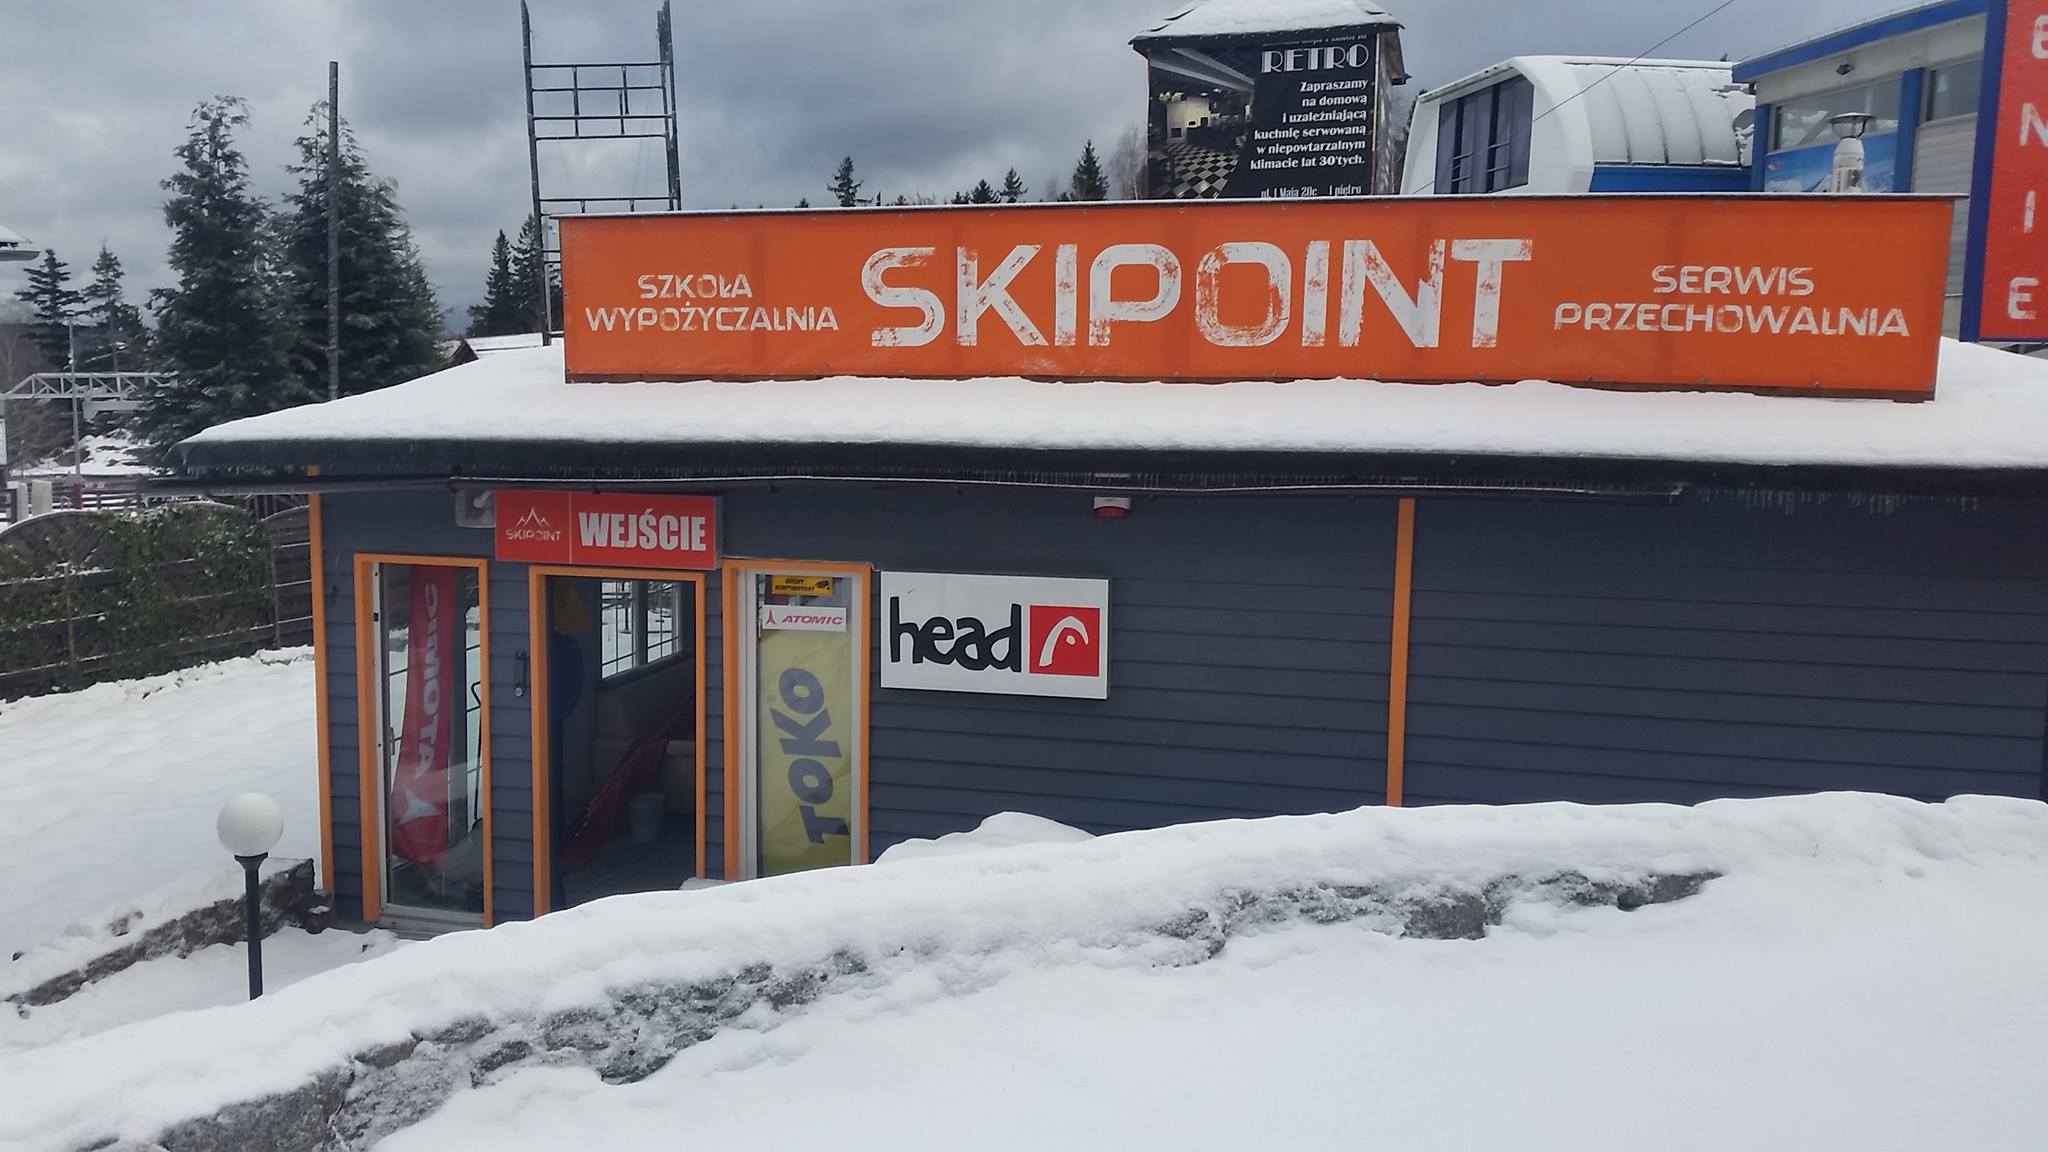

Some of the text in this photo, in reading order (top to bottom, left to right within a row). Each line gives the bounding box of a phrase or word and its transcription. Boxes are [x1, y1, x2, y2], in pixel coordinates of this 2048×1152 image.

[1261, 43, 1370, 73] RETRO
[1300, 79, 1369, 93] Zapraszamy
[1302, 94, 1368, 107] na domową
[1282, 109, 1367, 123] i uzależniającą
[1254, 125, 1367, 140] kuchnię serwowaną
[1268, 140, 1366, 155] niepowtarzalnym
[1250, 157, 1299, 170] klimacie
[1301, 157, 1317, 168] lat
[637, 273, 753, 299] SZKOŁA
[862, 238, 1532, 348] SKIPOINT
[1651, 265, 1815, 295] SERWIS
[585, 302, 839, 332] WYPOŻYCZALNIA
[1554, 303, 1909, 336] PRZECHOWALNIA
[505, 528, 561, 541] SKIPOINT
[578, 508, 707, 551] WEJŚCIE
[782, 615, 843, 625] ATOMIC
[890, 596, 1022, 673] head
[769, 668, 849, 843] TOKO
